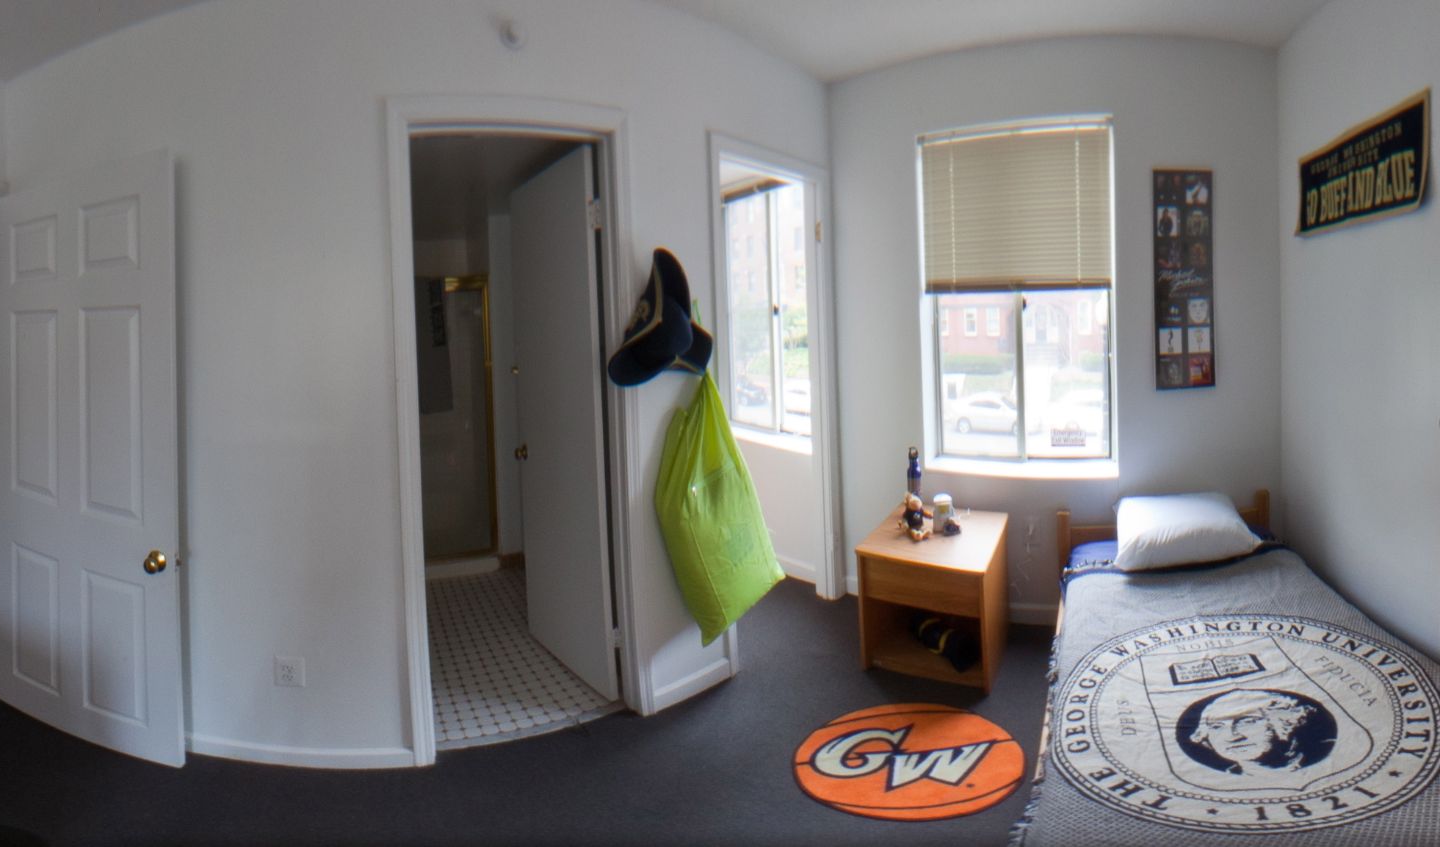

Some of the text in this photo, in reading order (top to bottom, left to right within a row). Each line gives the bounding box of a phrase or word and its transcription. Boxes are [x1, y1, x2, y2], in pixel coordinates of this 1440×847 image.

[1320, 176, 1347, 222] BUFF
[1347, 166, 1375, 212] AND
[1065, 621, 1431, 812] THE GEORGE WASHINGTON UNIVERSITY
[810, 722, 999, 793] GW
[1253, 785, 1381, 822] 1821
